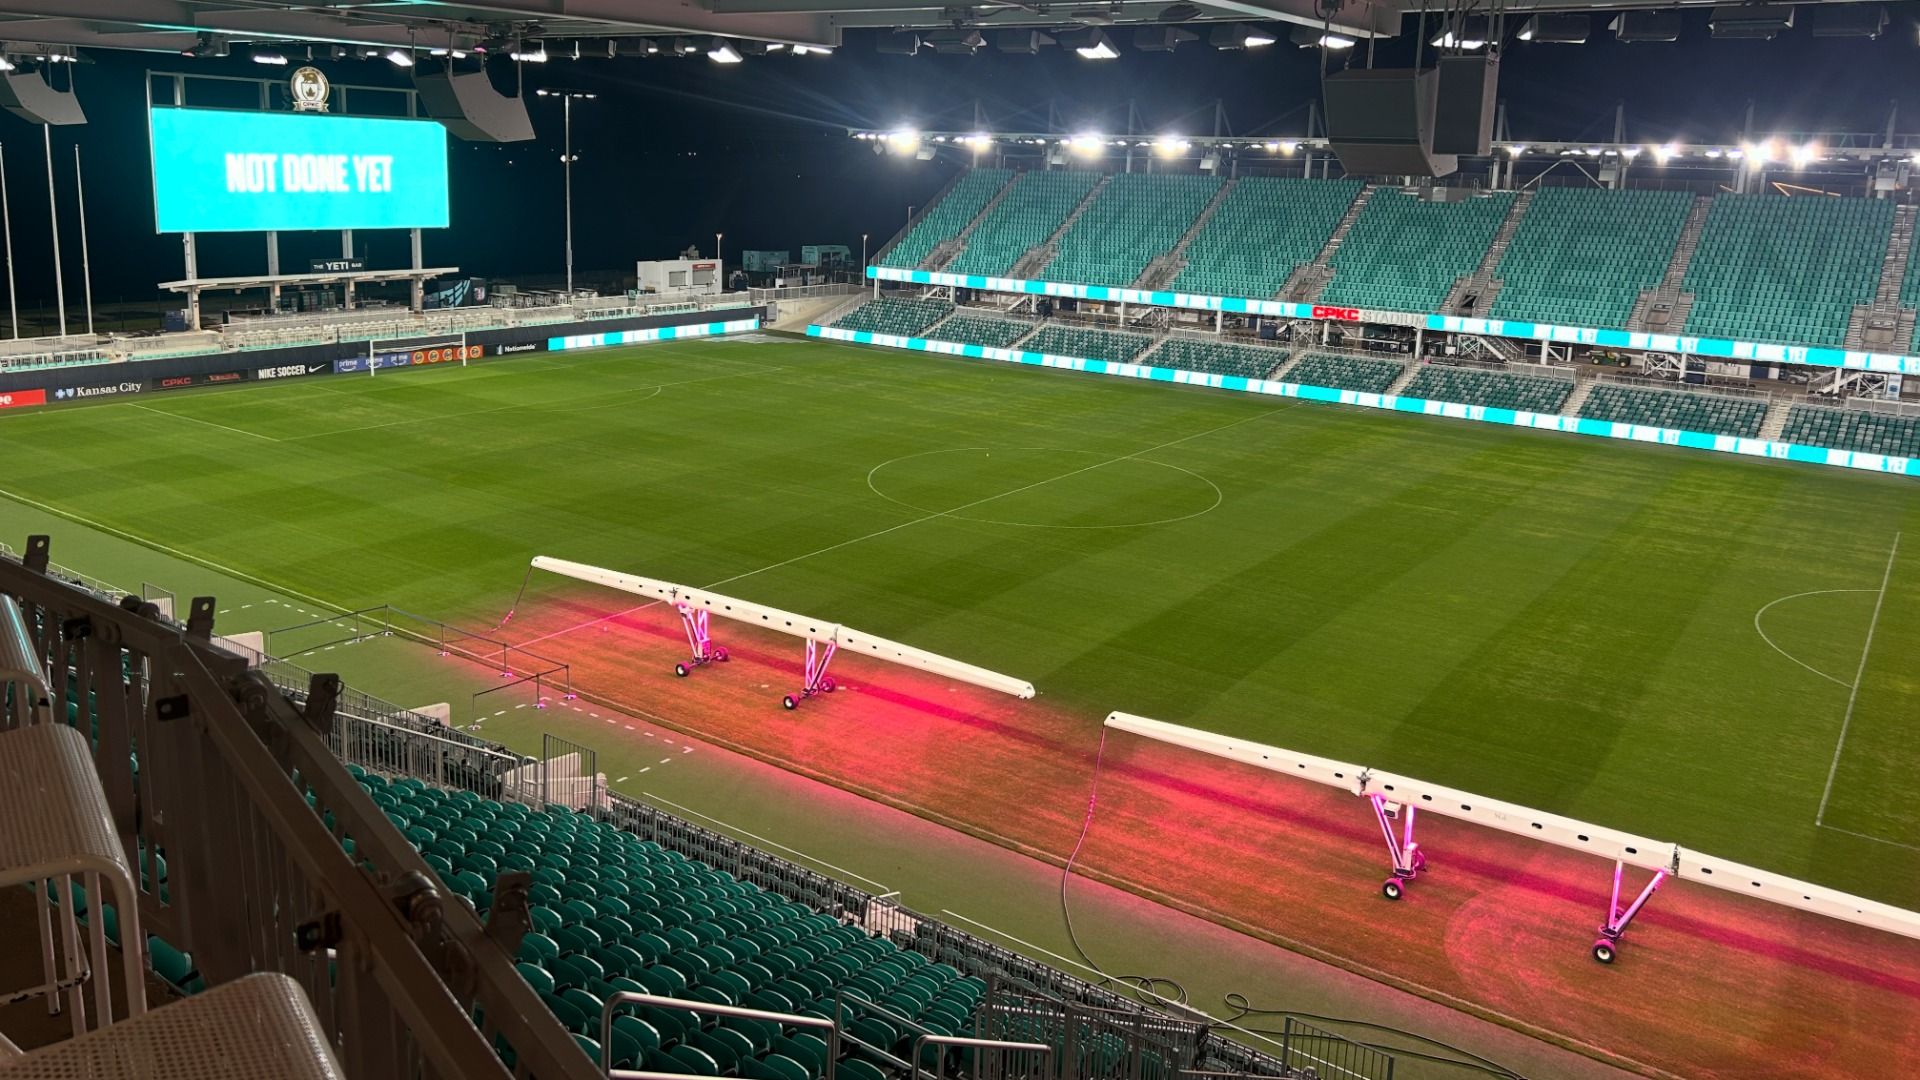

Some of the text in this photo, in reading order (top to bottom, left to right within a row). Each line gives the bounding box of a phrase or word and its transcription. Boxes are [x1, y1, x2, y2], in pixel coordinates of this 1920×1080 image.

[225, 153, 393, 193] NOT DONE YET
[326, 261, 349, 271] YETI
[1312, 305, 1360, 321] CPKC
[1363, 310, 1427, 327] STADIUM
[504, 343, 537, 353] Nationwide
[338, 360, 358, 368] prime
[258, 364, 306, 380] NIKE SOCCER
[162, 377, 192, 387] CPKC
[76, 382, 143, 398] Kansas City
